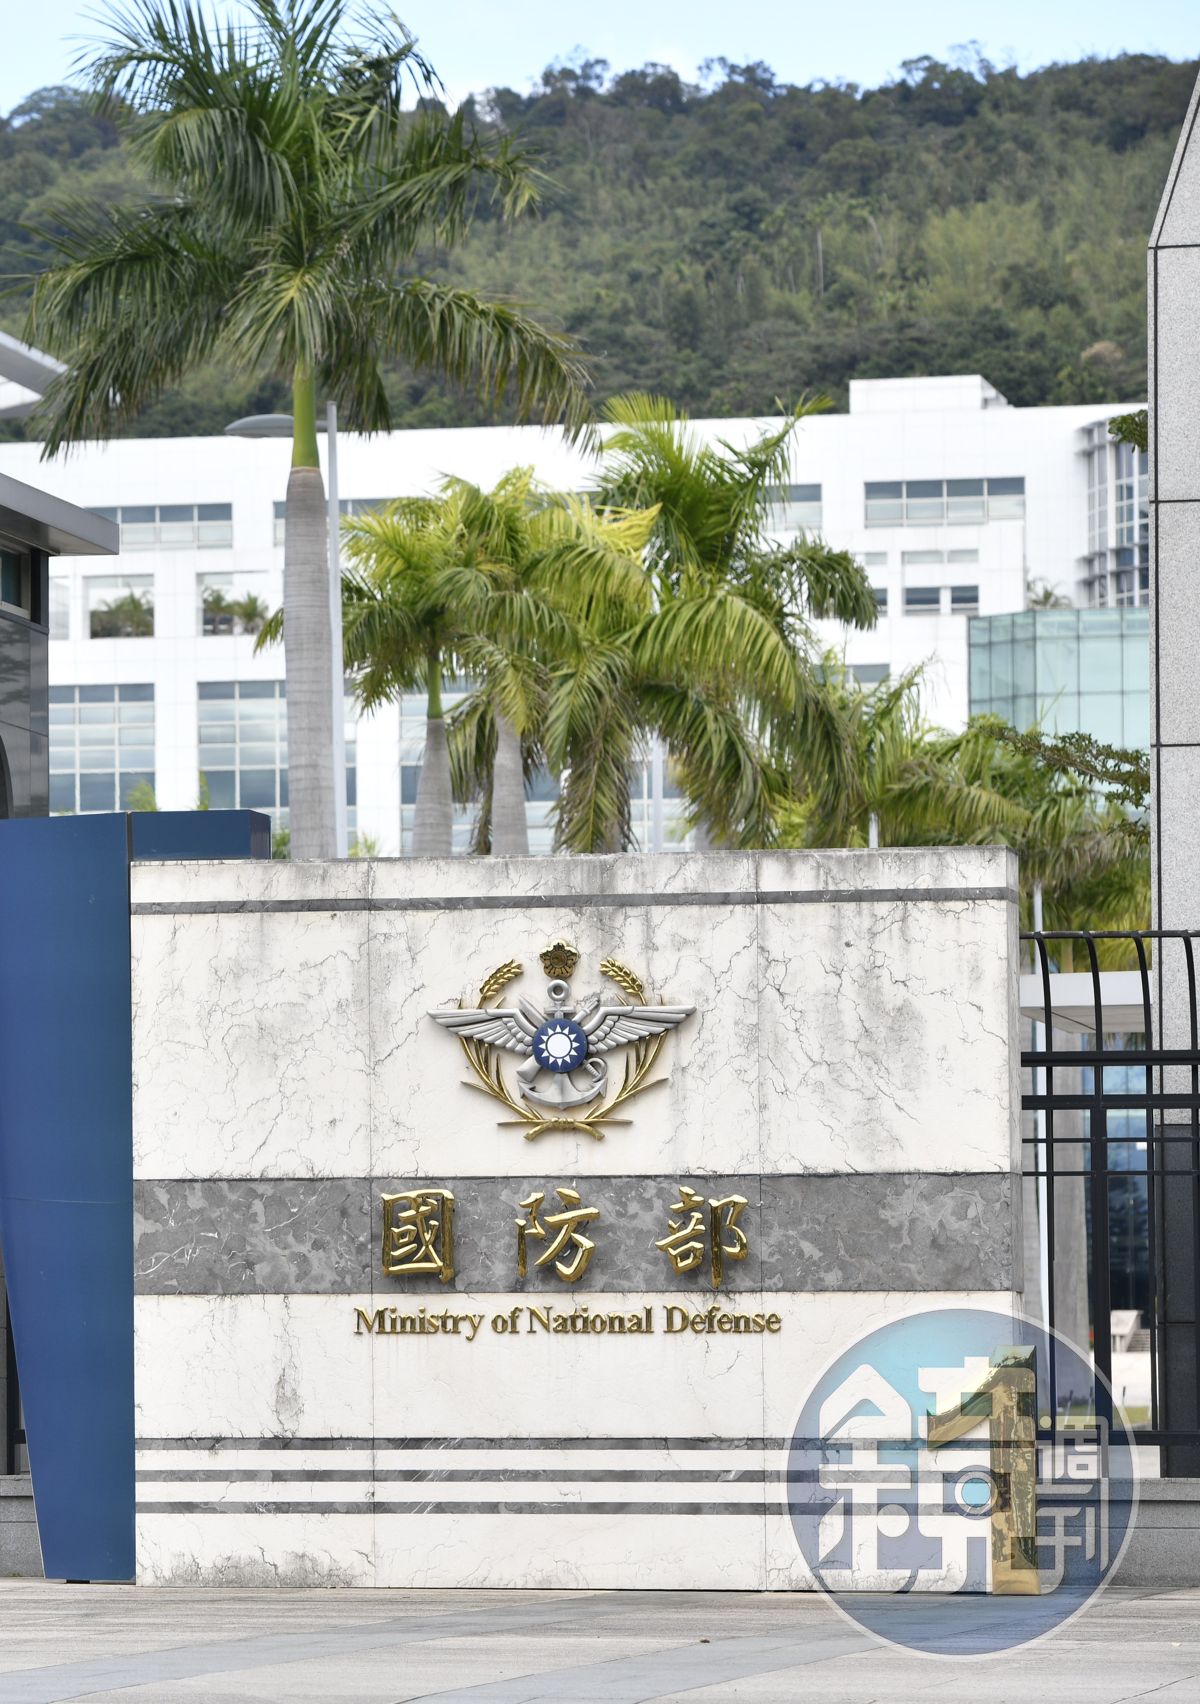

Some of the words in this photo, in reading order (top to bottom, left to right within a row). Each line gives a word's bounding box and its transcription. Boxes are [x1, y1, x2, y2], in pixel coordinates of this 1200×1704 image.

[381, 1186, 748, 1289] 國防部
[354, 1306, 485, 1341] Ministry
[491, 1306, 523, 1334] of
[526, 1306, 655, 1334] National
[663, 1305, 782, 1334] Defense
